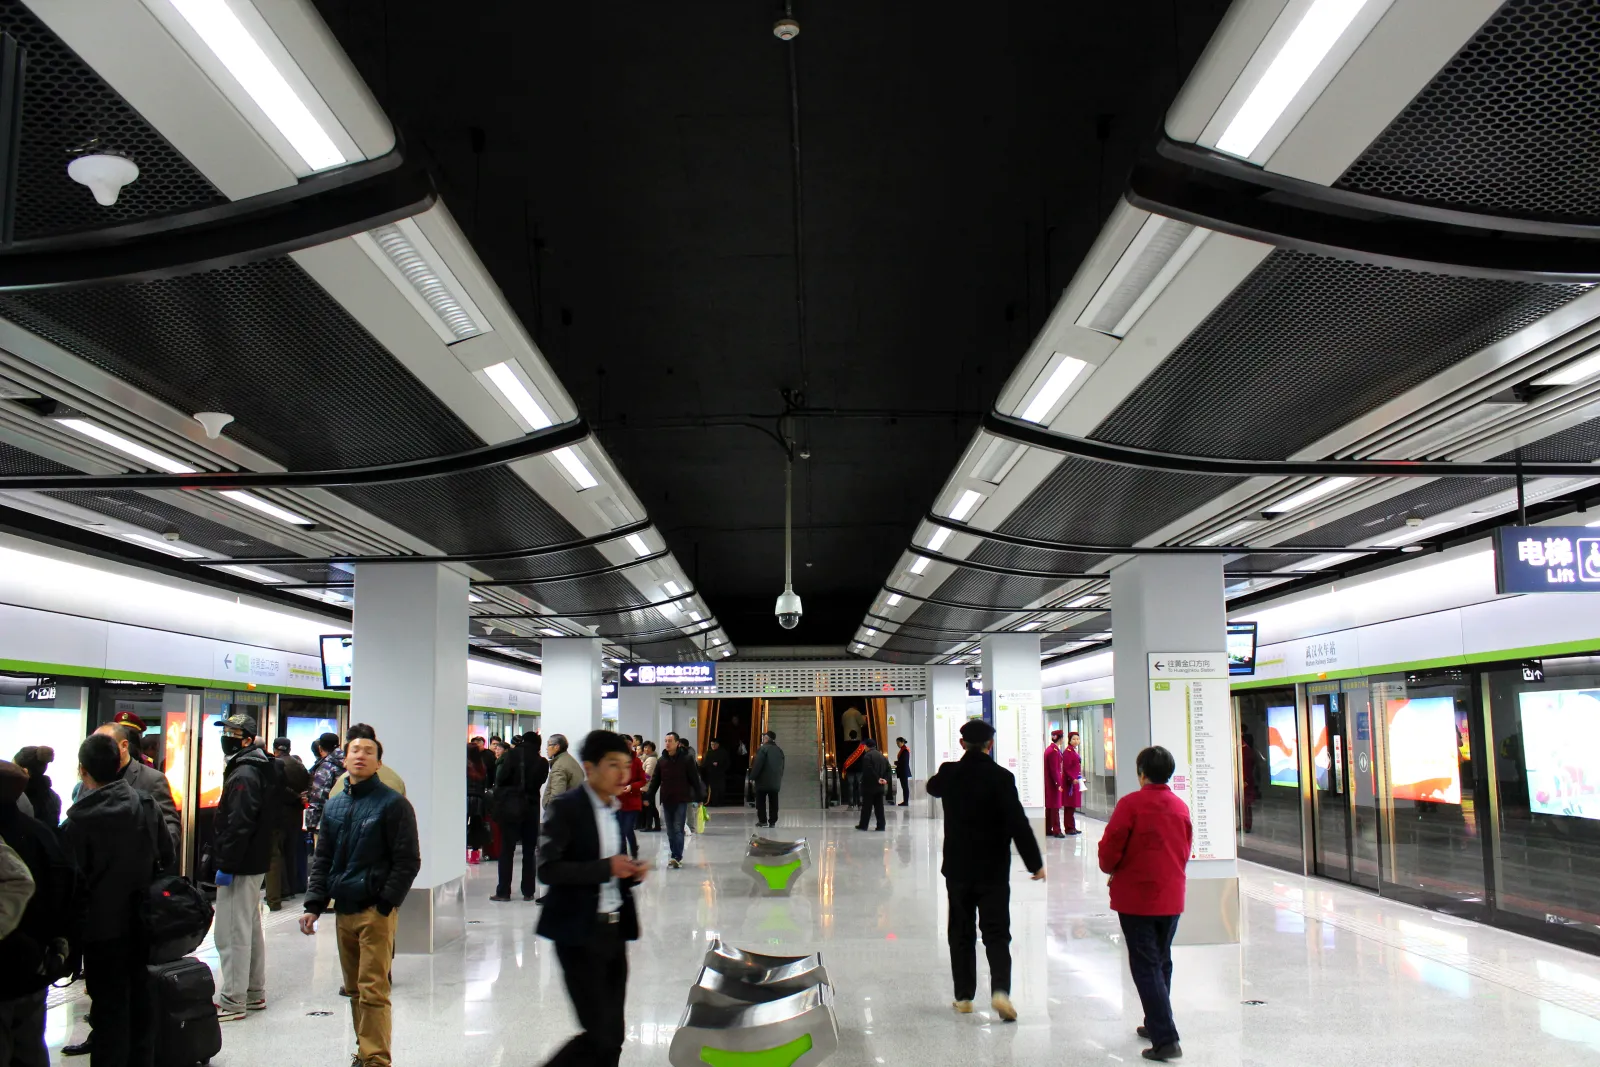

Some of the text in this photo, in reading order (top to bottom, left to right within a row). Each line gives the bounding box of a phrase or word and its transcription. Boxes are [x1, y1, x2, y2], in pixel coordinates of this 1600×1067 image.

[1518, 538, 1573, 566] 电梯
[1547, 569, 1575, 583] Lift
[1305, 641, 1336, 659] 武汉火车站
[1168, 660, 1210, 668] 往黄金口方向
